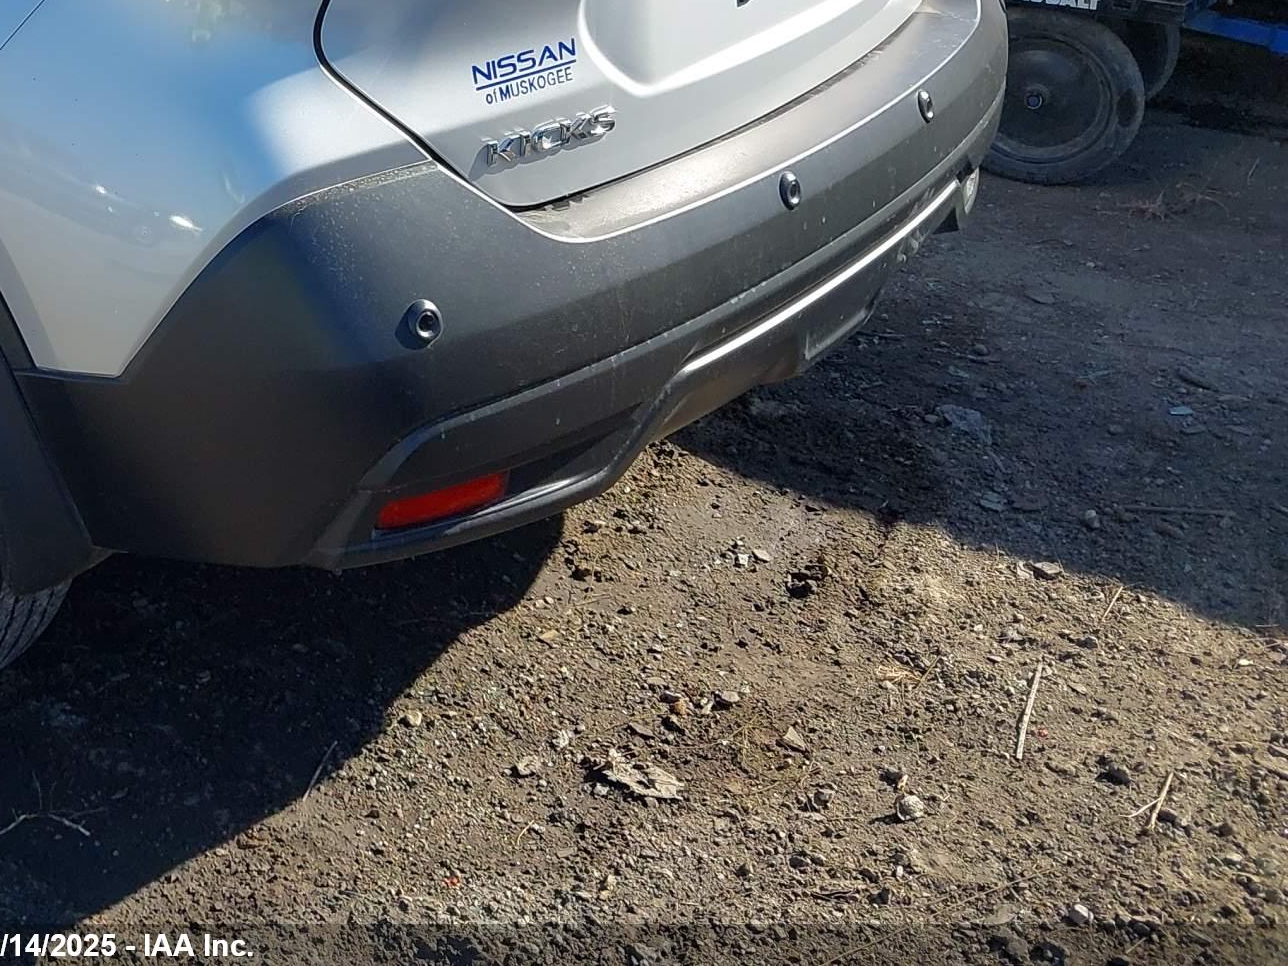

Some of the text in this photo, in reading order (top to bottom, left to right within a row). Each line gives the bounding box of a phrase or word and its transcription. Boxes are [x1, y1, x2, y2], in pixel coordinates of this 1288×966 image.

[471, 38, 577, 85] NISSAN
[485, 66, 574, 105] of MUSKOGEE
[483, 105, 617, 166] KICKS
